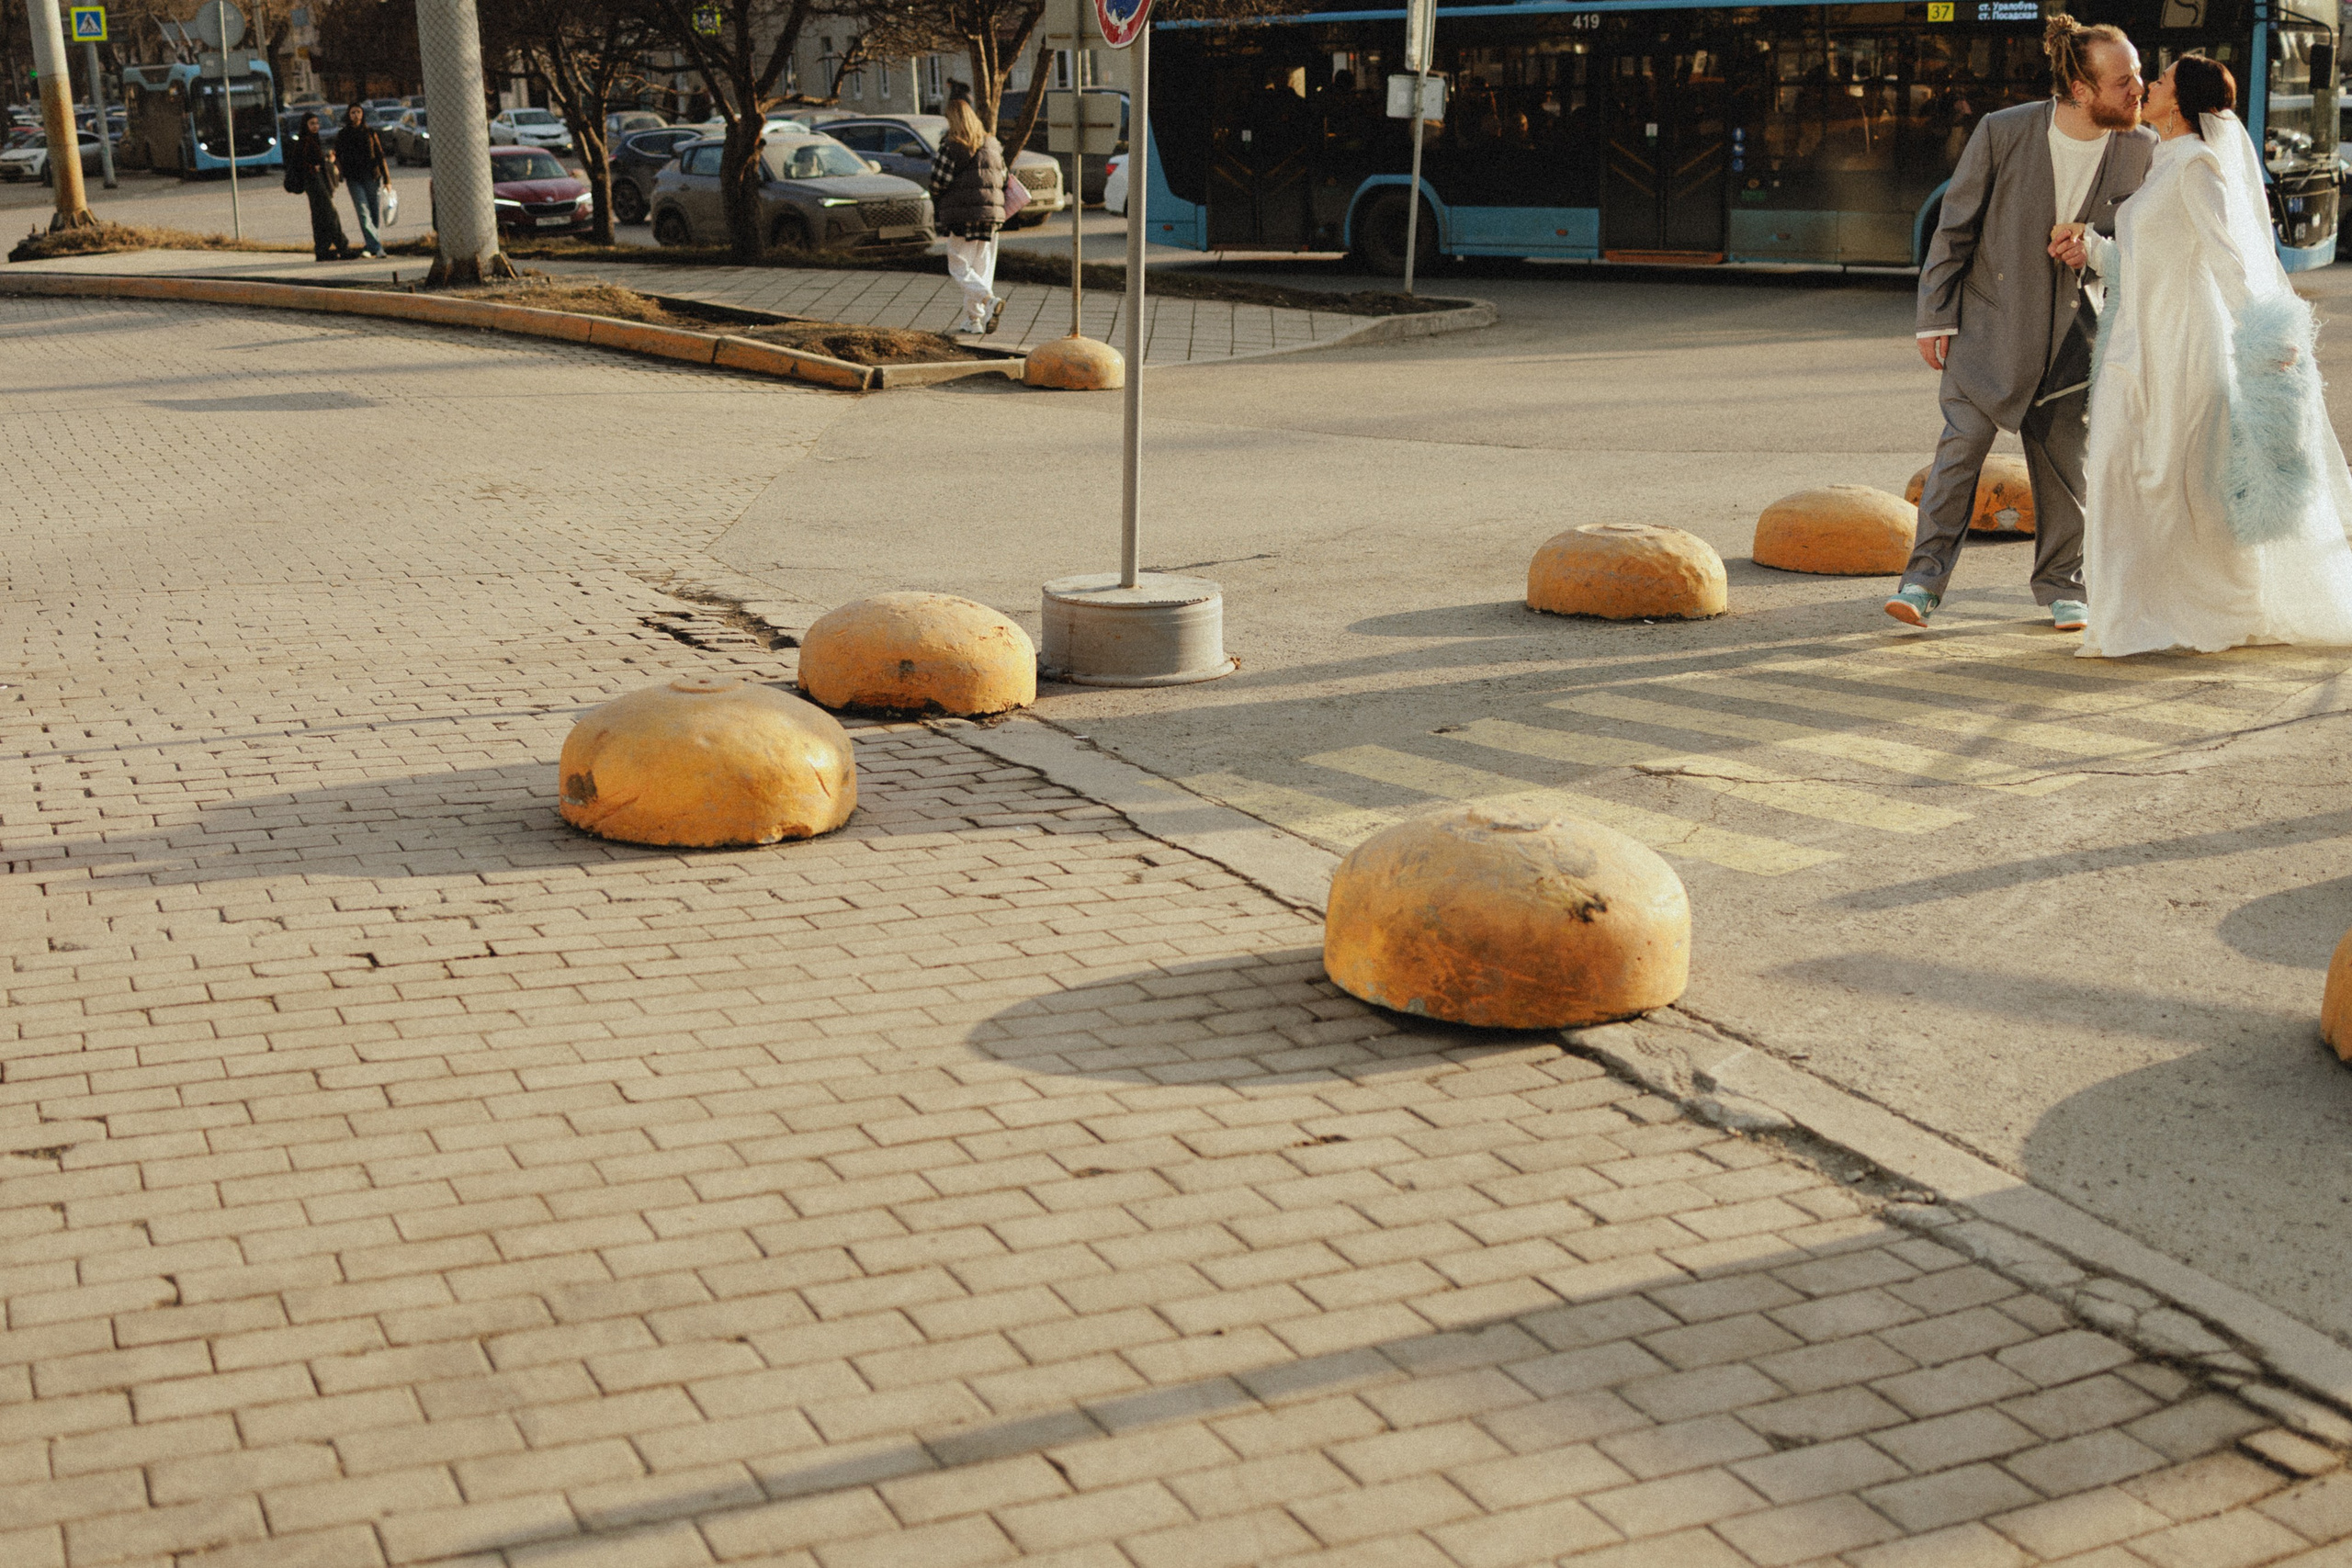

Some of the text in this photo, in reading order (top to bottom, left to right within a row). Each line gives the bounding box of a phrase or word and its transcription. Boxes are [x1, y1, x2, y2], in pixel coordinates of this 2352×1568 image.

[1930, 5, 1950, 19] 37
[1992, 10, 2038, 19] Посадская
[1572, 14, 1600, 28] 419
